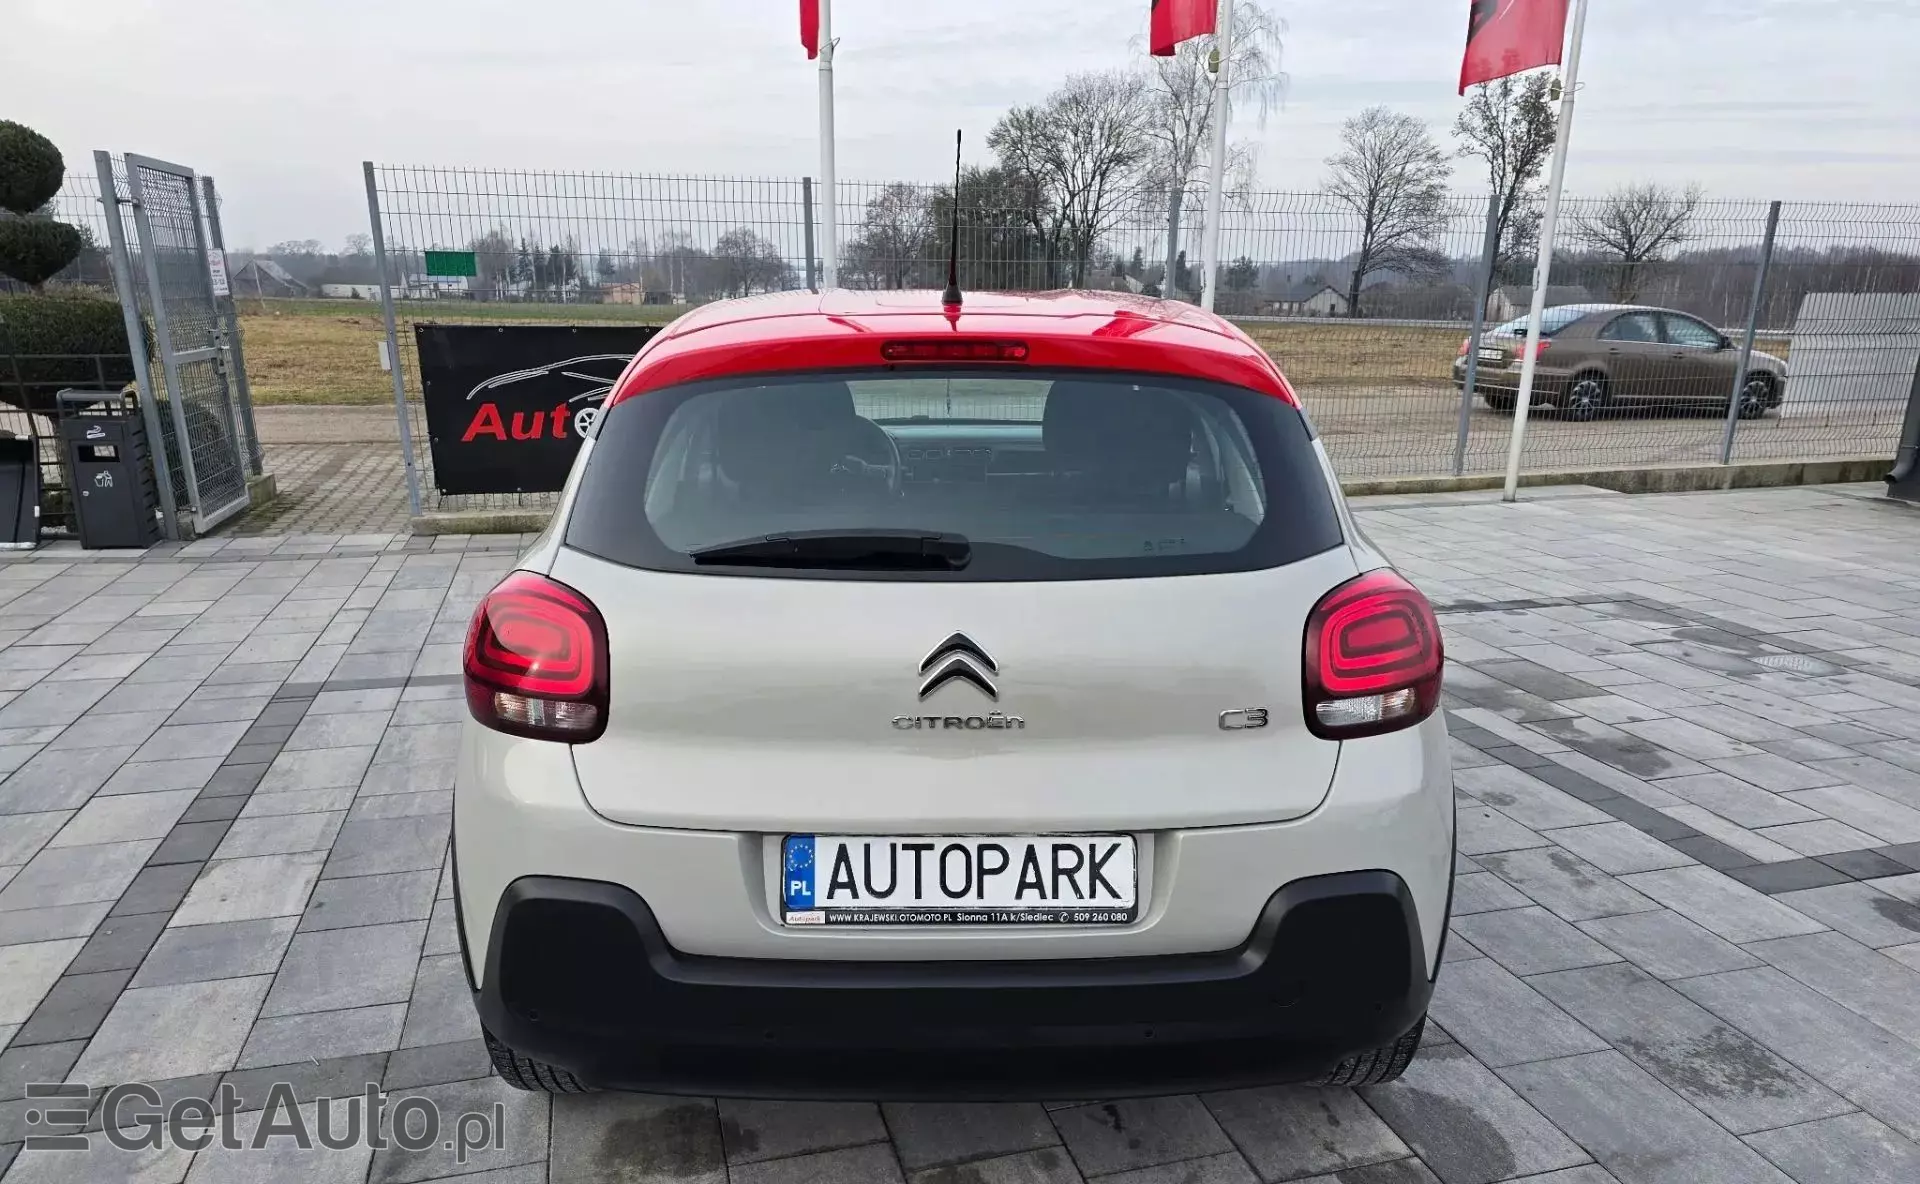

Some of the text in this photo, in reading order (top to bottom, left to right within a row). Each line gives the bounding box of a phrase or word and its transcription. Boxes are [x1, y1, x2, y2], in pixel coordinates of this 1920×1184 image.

[1217, 706, 1269, 730] C3
[826, 842, 1123, 900] AUTOPARK
[790, 880, 811, 896] PL
[991, 912, 1008, 922] 11A
[1074, 912, 1090, 922] 509
[1092, 912, 1109, 922] 260
[1111, 912, 1128, 922] 080
